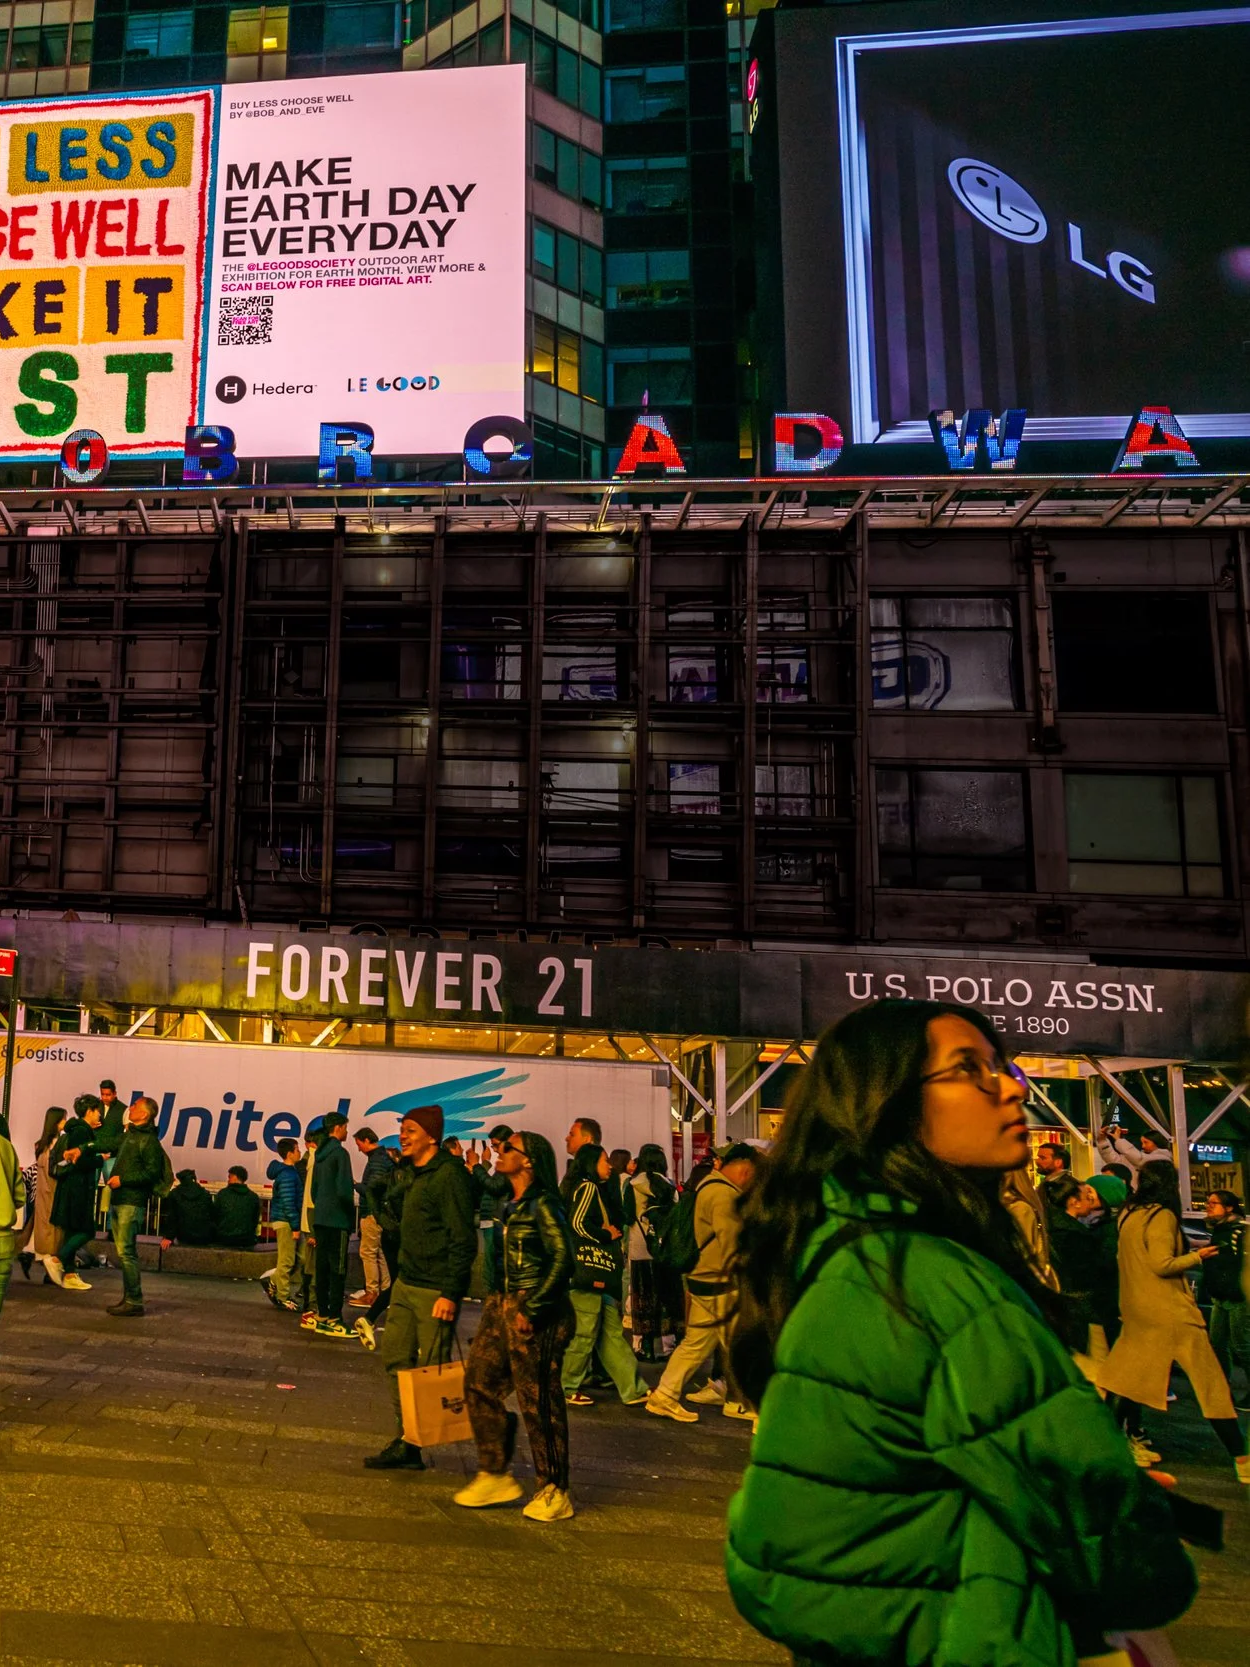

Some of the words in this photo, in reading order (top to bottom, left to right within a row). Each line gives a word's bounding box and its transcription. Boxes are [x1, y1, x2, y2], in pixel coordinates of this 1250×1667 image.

[229, 110, 243, 119] BY
[245, 105, 325, 118] @BOB_AND_EVE
[230, 100, 250, 110] BUY
[253, 98, 278, 109] LESS
[280, 96, 324, 107] CHOOSE
[325, 94, 354, 104] WELL
[24, 121, 178, 183] LESS
[225, 157, 352, 191] MAKE
[224, 189, 370, 224] EARTH
[388, 183, 477, 216] DAY
[50, 199, 186, 260] WELL
[222, 219, 457, 258] EVERYDAY
[222, 263, 245, 272] THE
[247, 258, 356, 271] @LEGOODSOCIETY
[358, 256, 418, 267] OUTDOOR
[421, 254, 445, 263] ART
[222, 270, 287, 282] EXHIBITION
[289, 270, 313, 280] FOR
[316, 268, 354, 278] EARTH
[357, 266, 403, 277] MONTH.
[406, 264, 437, 274] VIEW
[439, 263, 474, 273] MORE
[478, 263, 486, 272] &
[1069, 222, 1155, 303] LG
[221, 283, 252, 292] SCAN
[255, 280, 296, 291] BELOW
[299, 279, 324, 289] FOR
[326, 278, 356, 288] FREE
[358, 276, 404, 287] DIGITAL
[406, 275, 432, 284] ART.
[105, 277, 174, 336] IT
[252, 382, 314, 396] Hedera
[247, 942, 503, 1013] FOREVER
[537, 958, 592, 1018] 21
[846, 972, 914, 1000] U.S.
[926, 975, 1033, 1006] POLO
[1044, 979, 1164, 1013] ASSN.
[1015, 1016, 1070, 1035] 1890
[16, 1044, 85, 1064] Logistics
